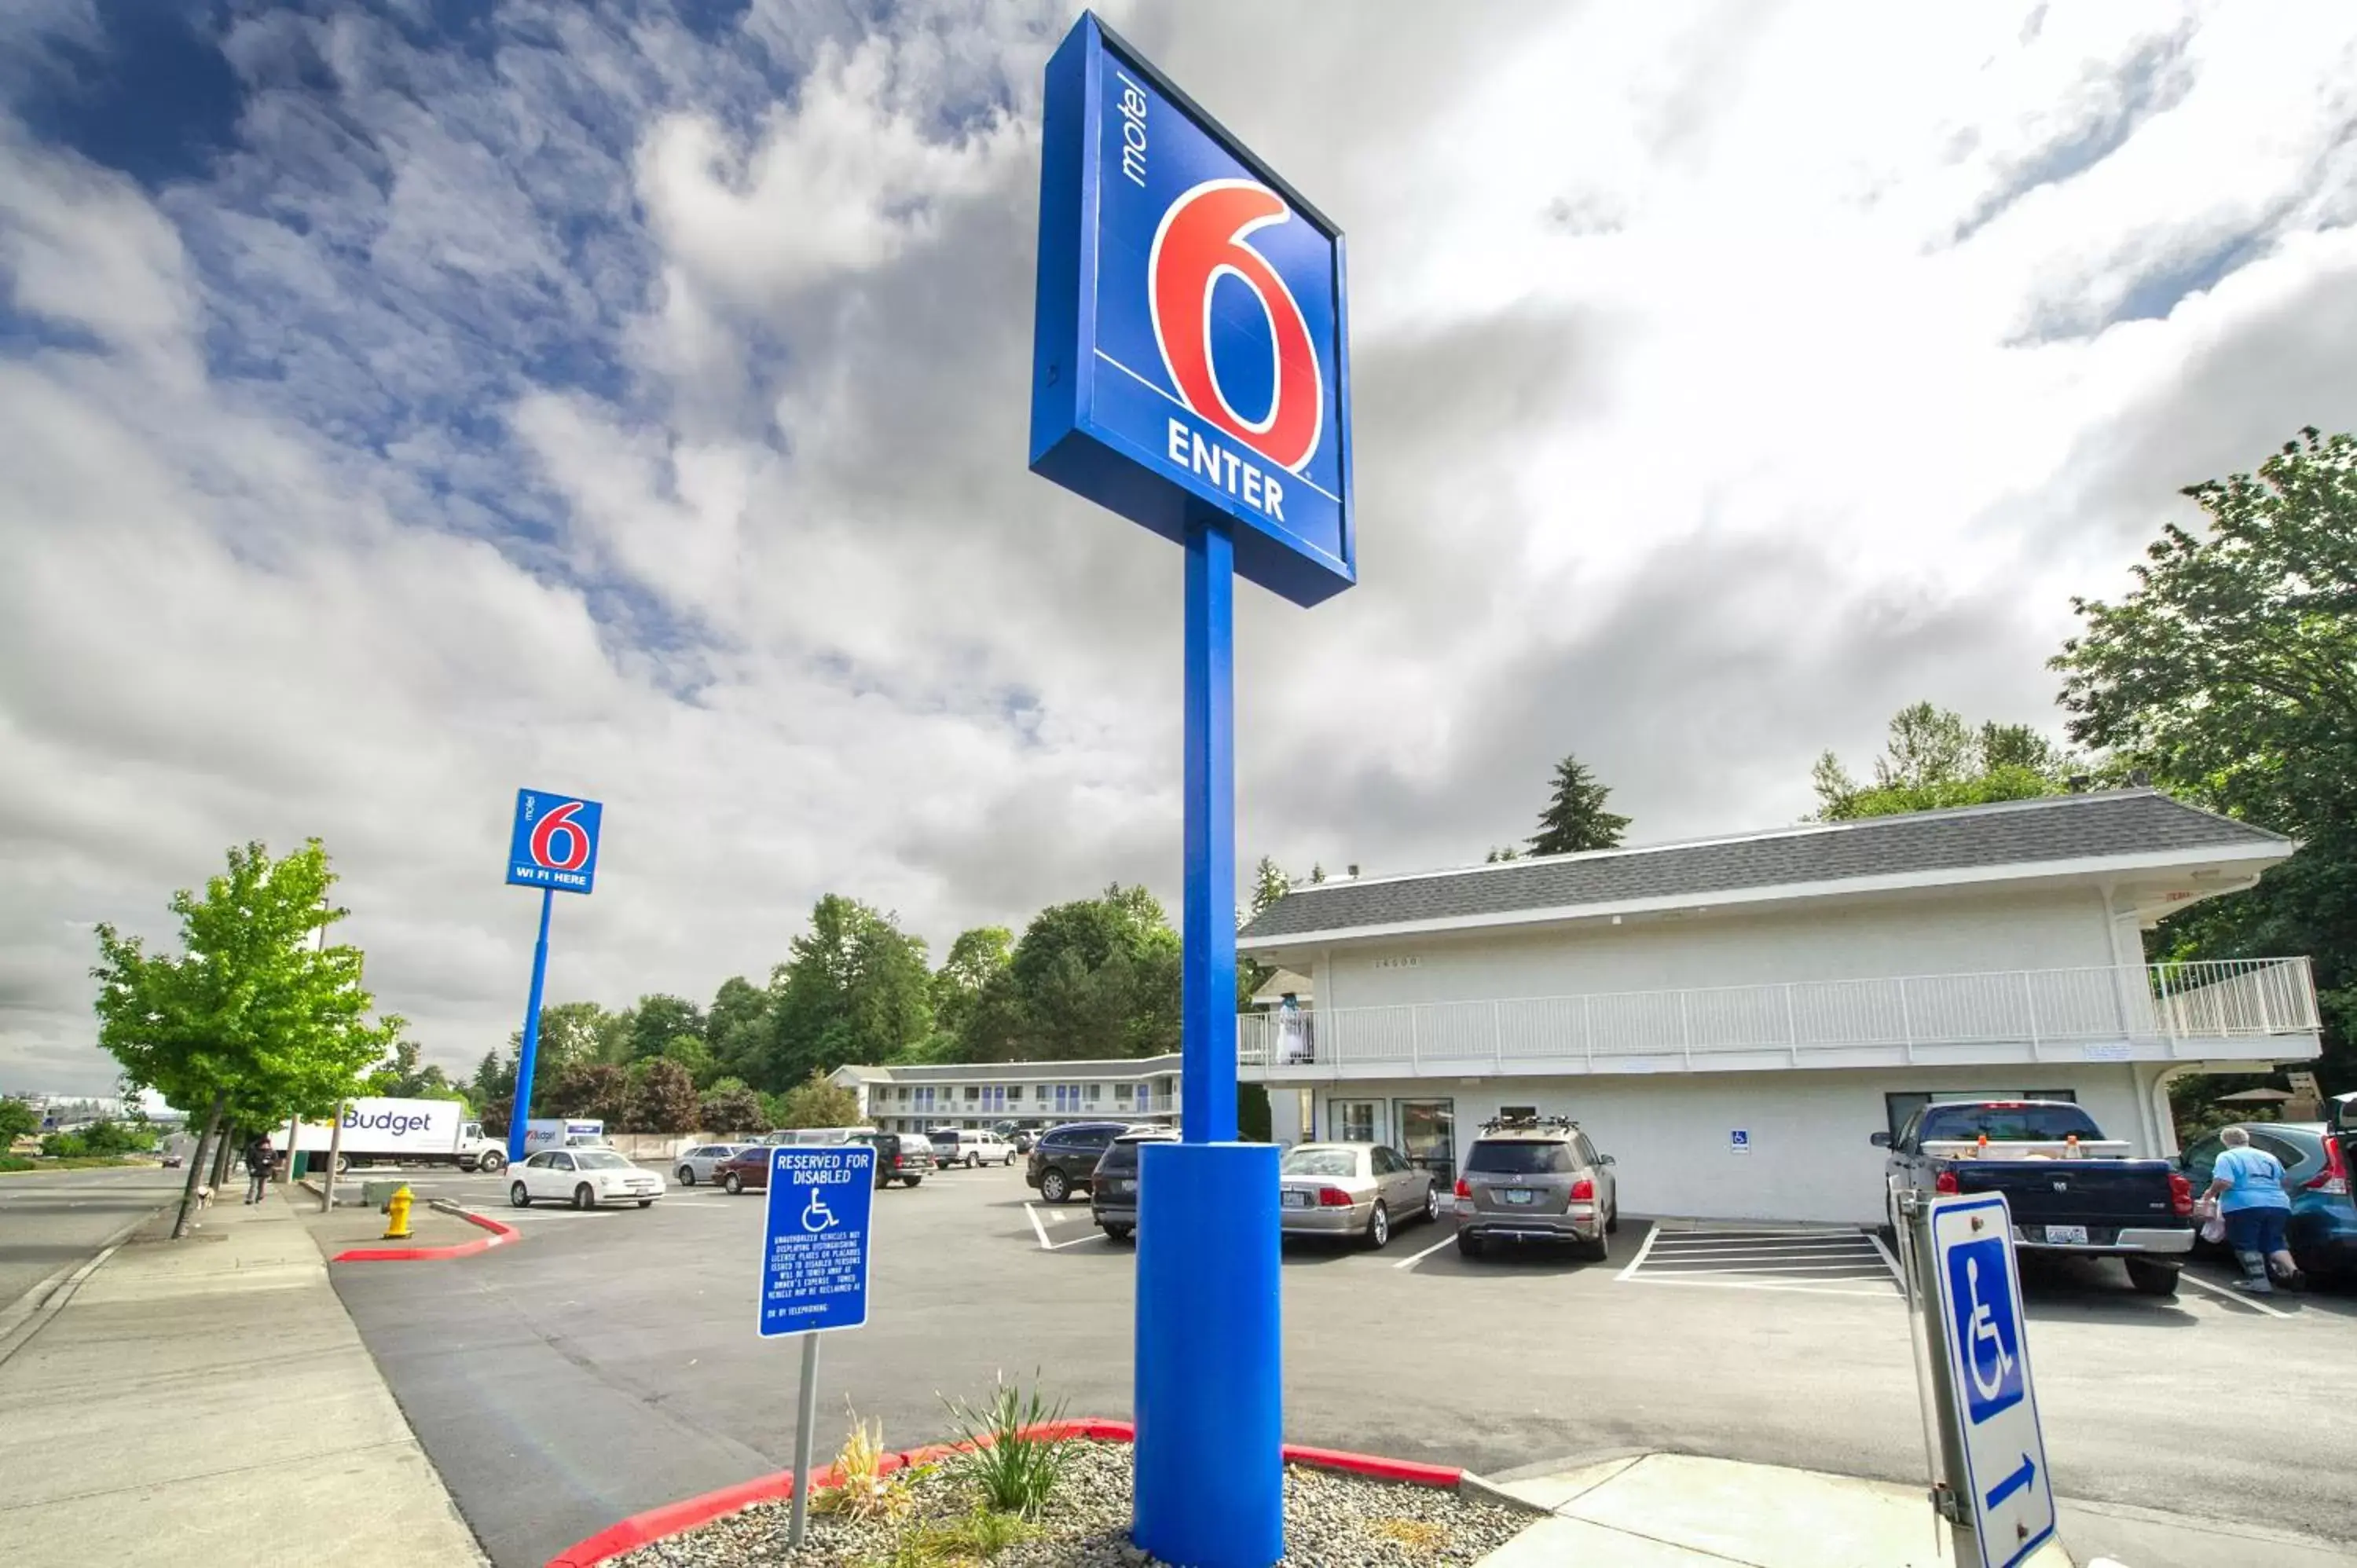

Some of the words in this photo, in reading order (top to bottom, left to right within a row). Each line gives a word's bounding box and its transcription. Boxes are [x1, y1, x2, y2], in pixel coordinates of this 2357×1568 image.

[1116, 69, 1146, 188] motel
[1148, 178, 1324, 474] 6
[1168, 416, 1285, 522] ENTER
[525, 795, 535, 821] motel
[530, 801, 590, 871] 6
[516, 866, 533, 878] WI
[537, 870, 549, 881] FI
[554, 873, 586, 885] HERE
[343, 1110, 431, 1136] Budget
[777, 1154, 841, 1170] RESERVED
[845, 1154, 869, 1168] FOR
[793, 1170, 851, 1185] DISABLED
